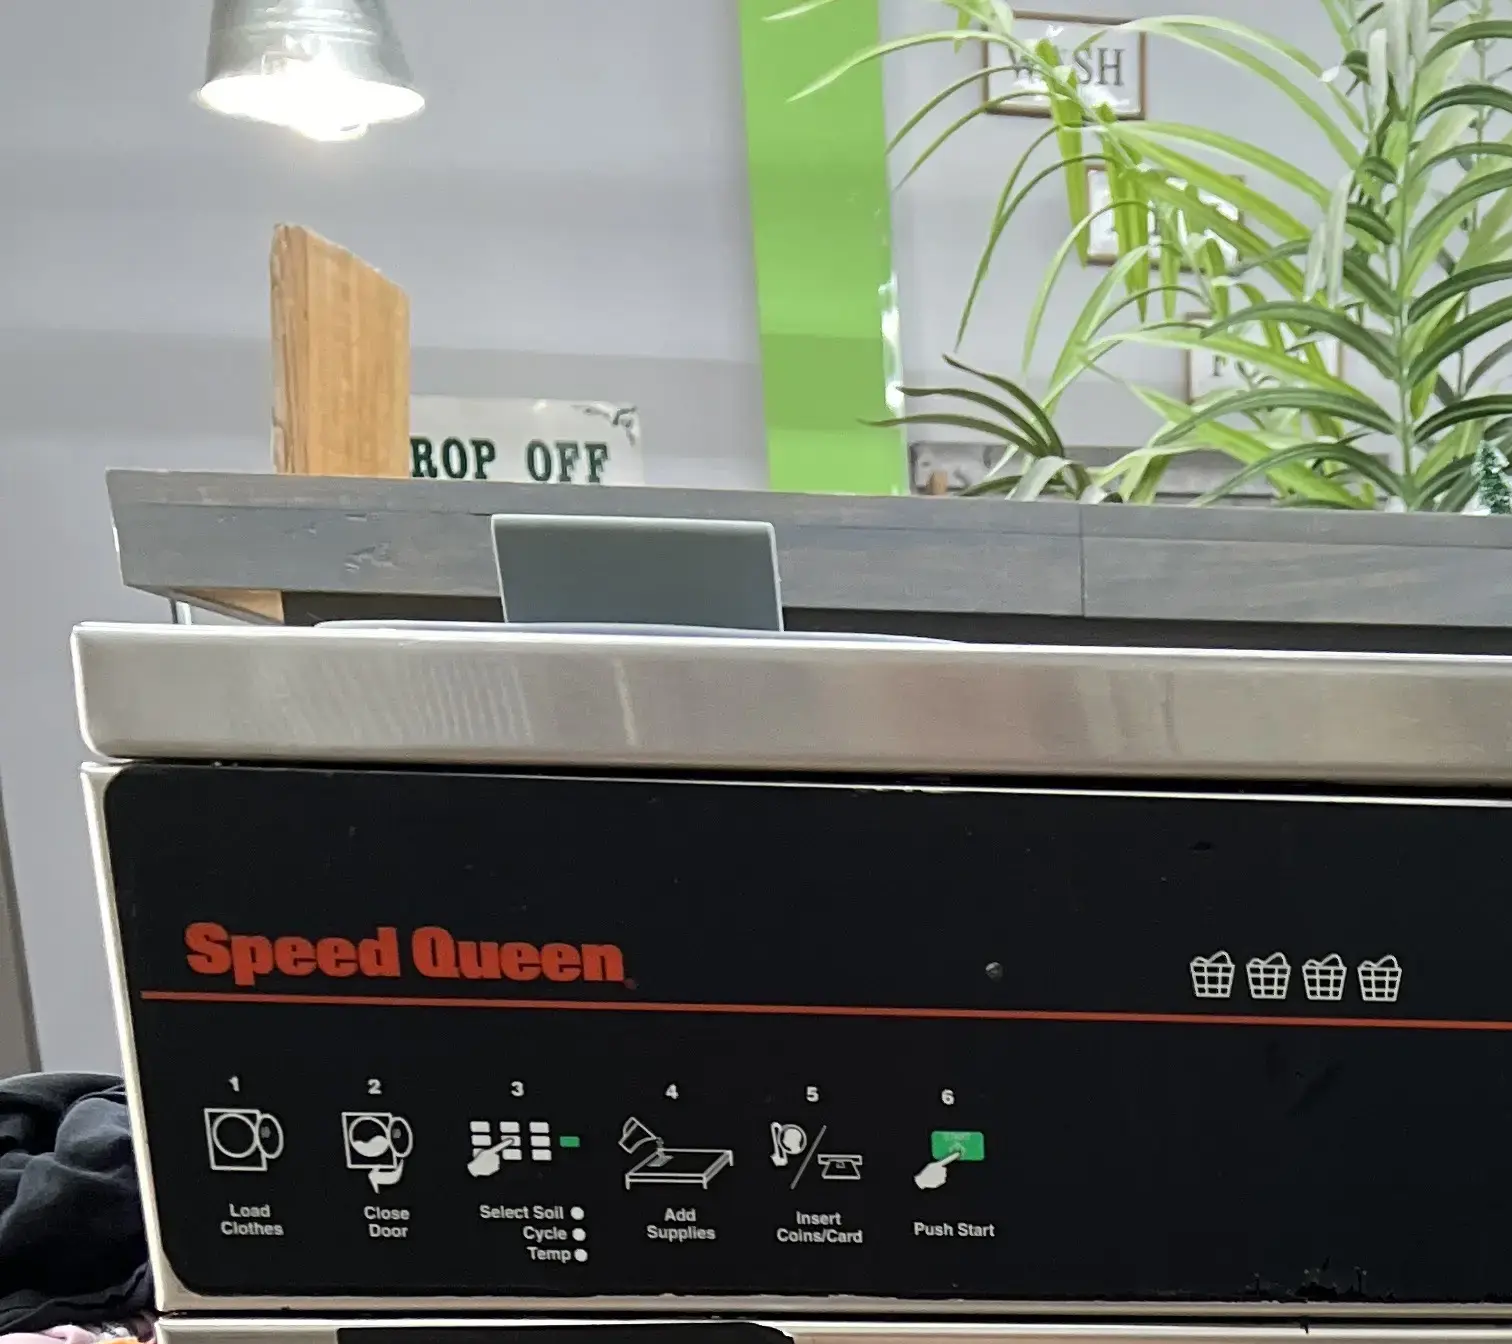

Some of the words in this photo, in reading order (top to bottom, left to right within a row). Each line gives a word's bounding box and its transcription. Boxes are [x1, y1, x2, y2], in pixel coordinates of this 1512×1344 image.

[410, 437, 496, 479] ROP
[527, 439, 609, 483] OFF
[184, 921, 400, 987] Speed
[412, 925, 624, 982] Queen
[229, 1076, 241, 1091] 1
[367, 1079, 382, 1095] 2
[510, 1081, 525, 1097] 3
[665, 1085, 679, 1100] 4
[806, 1087, 819, 1102] 5
[941, 1090, 954, 1105] 6
[229, 1204, 271, 1219] Load
[364, 1206, 410, 1221] Close
[480, 1205, 528, 1221] Select
[533, 1205, 564, 1221] Soil
[664, 1209, 696, 1224] Add
[795, 1211, 841, 1228] Insert
[221, 1220, 284, 1237] Clothes
[369, 1223, 408, 1239] Door
[523, 1226, 567, 1243] Cycle
[646, 1224, 716, 1244] Supplies
[914, 1221, 953, 1240] Push
[957, 1222, 995, 1238] Start
[776, 1228, 863, 1246] Coins/Card
[527, 1247, 572, 1263] Temp
